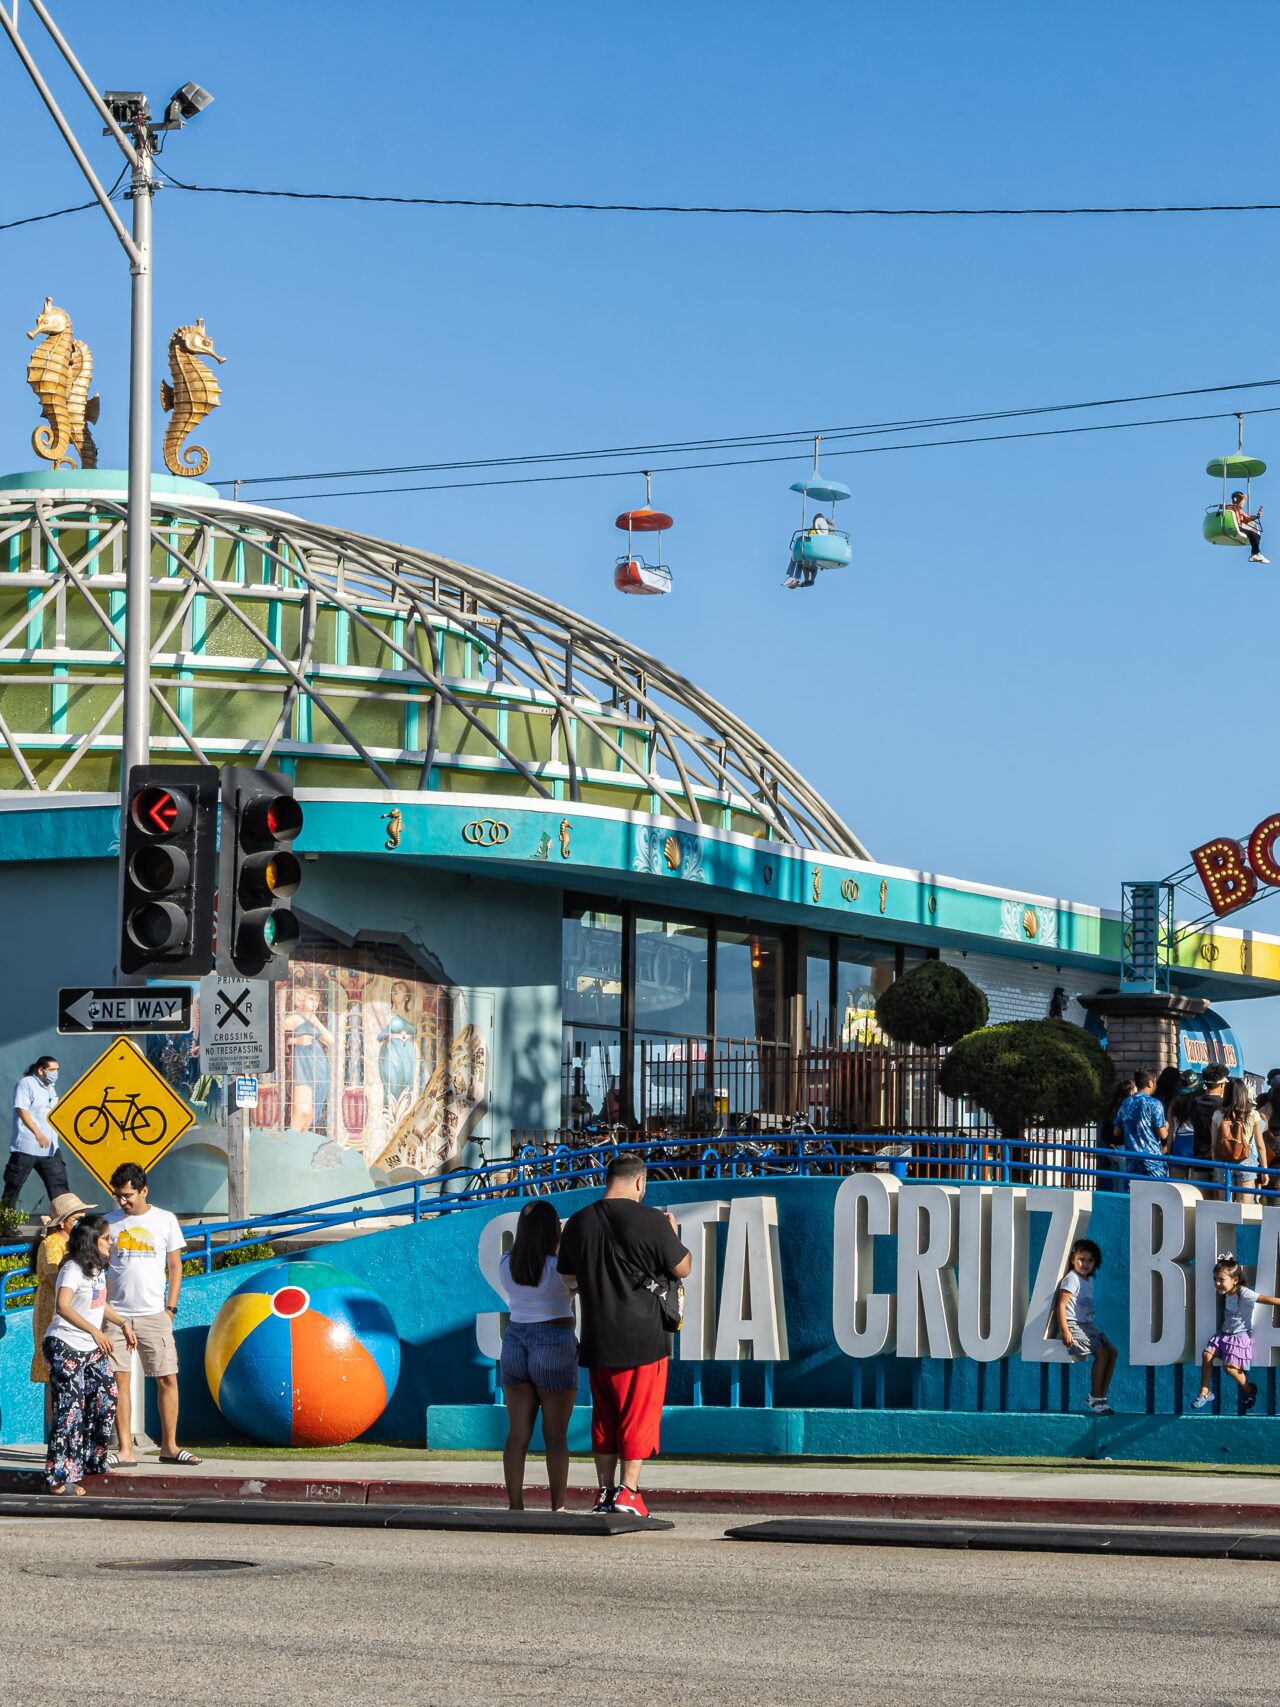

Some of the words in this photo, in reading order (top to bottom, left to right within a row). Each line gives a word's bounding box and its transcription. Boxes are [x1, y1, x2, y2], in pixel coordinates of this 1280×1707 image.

[137, 1001, 178, 1019] WAY
[214, 1003, 222, 1015] R
[245, 1001, 253, 1013] R
[214, 1031, 254, 1042] CROSSING
[205, 1047, 215, 1056] NO
[217, 1045, 263, 1056] TRESPASSING
[832, 1172, 1092, 1364] CRUZ
